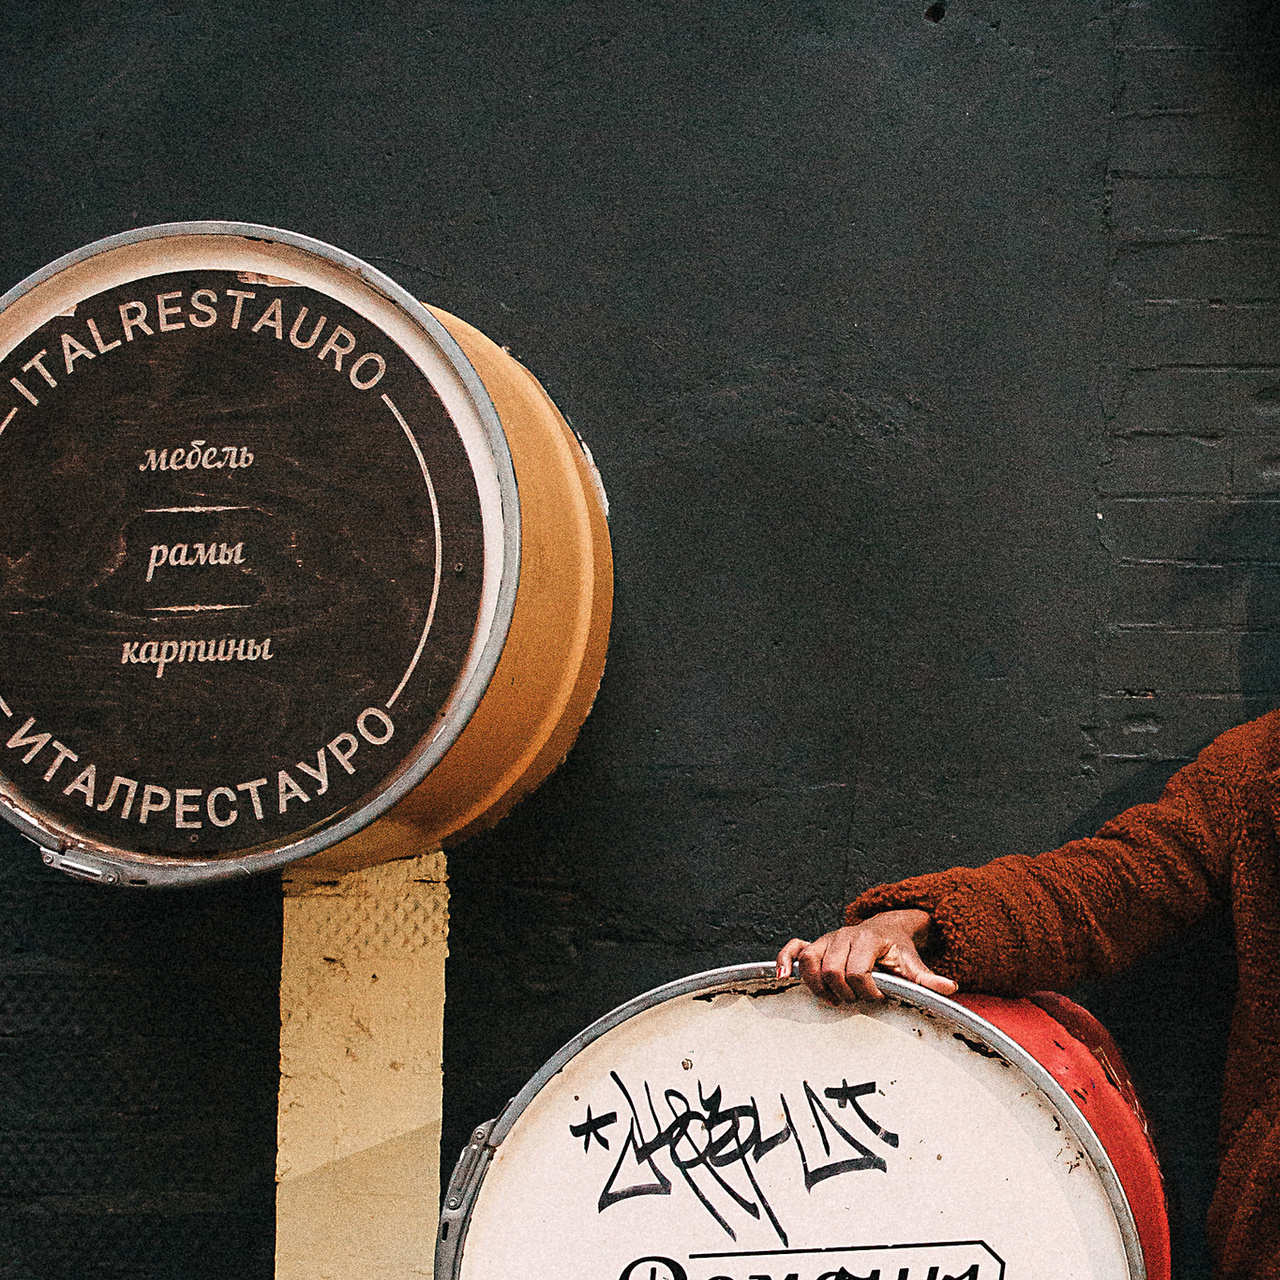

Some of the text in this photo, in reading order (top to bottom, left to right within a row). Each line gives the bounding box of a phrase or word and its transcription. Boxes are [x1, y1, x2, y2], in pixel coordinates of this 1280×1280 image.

[10, 289, 387, 406] ITALRESTAURO
[139, 439, 254, 472] мебель
[145, 541, 247, 583] рамы
[121, 638, 274, 679] картины
[6, 706, 395, 829] ИТАЛРЕСТАУРО
